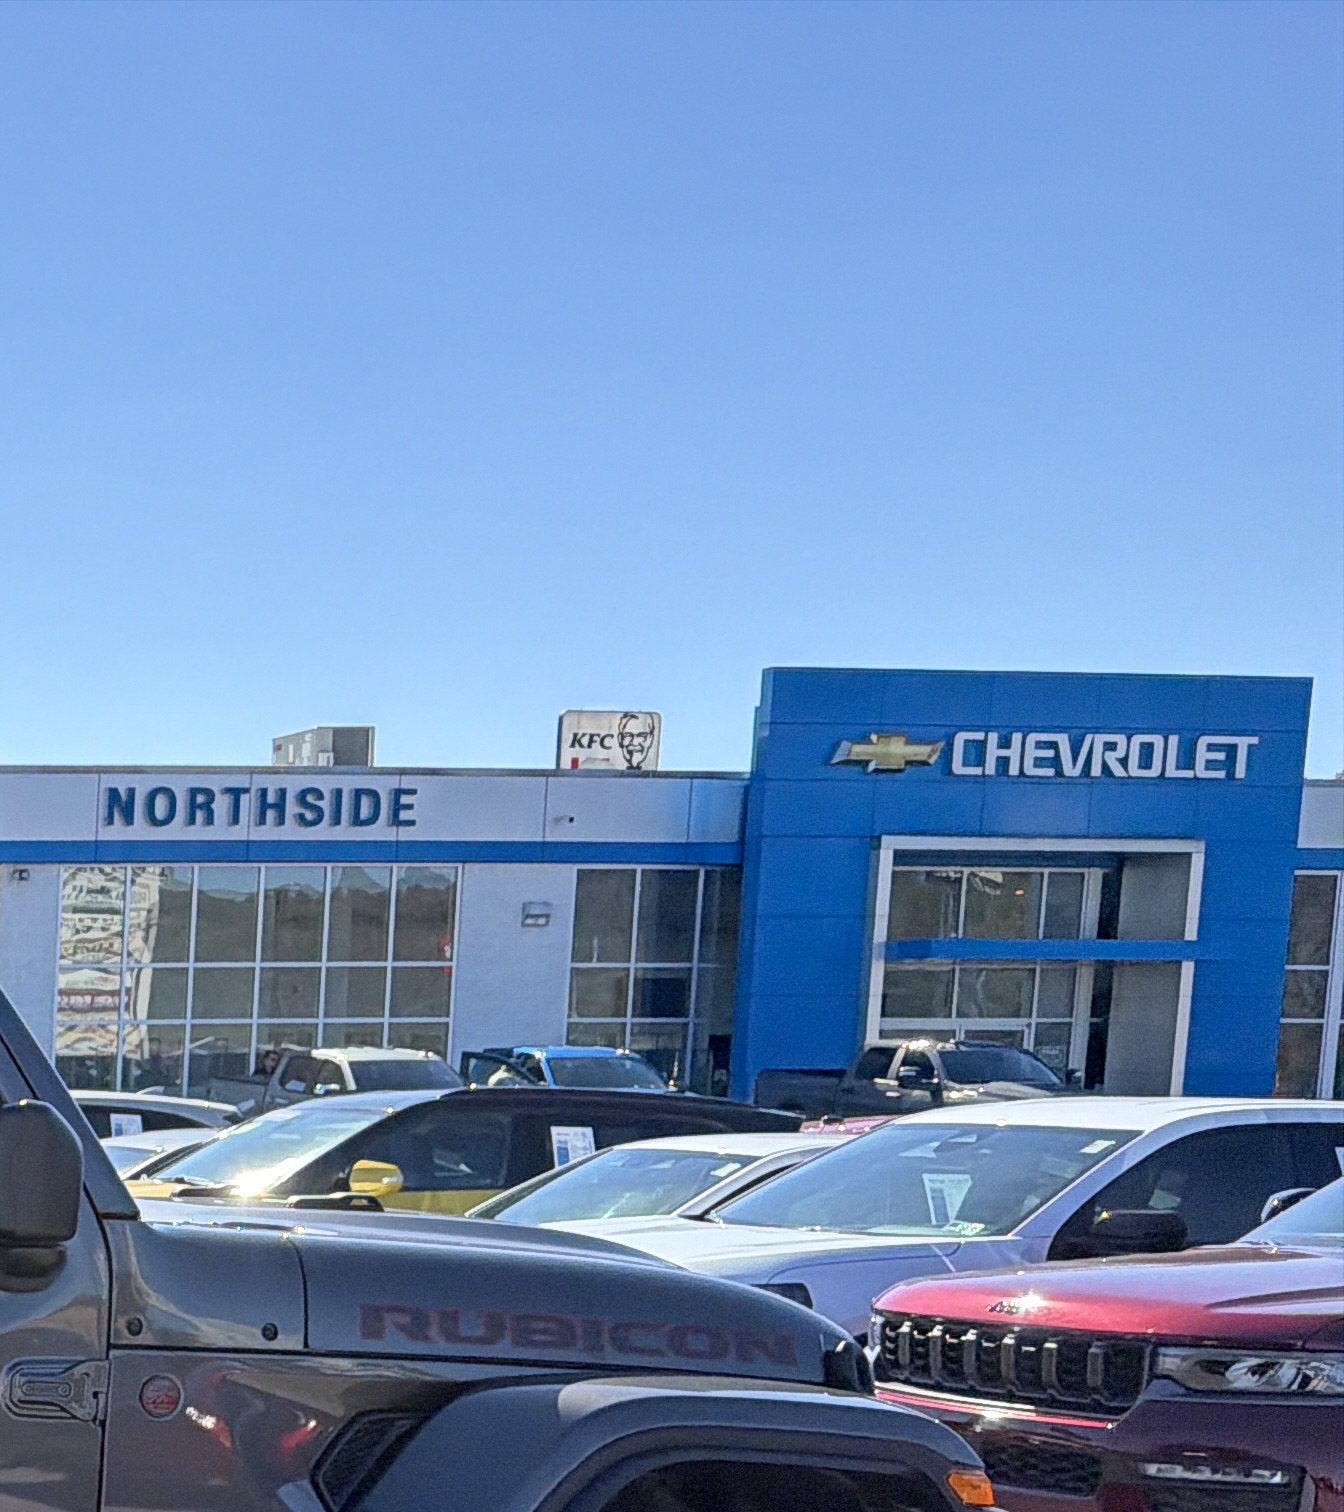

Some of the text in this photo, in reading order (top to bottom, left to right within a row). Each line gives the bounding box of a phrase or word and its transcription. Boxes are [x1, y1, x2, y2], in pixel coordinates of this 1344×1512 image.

[568, 732, 614, 750] KFC
[951, 731, 1259, 779] CHEVROLET
[104, 785, 419, 828] NORTHSIDE
[357, 1303, 799, 1367] RUBICON
